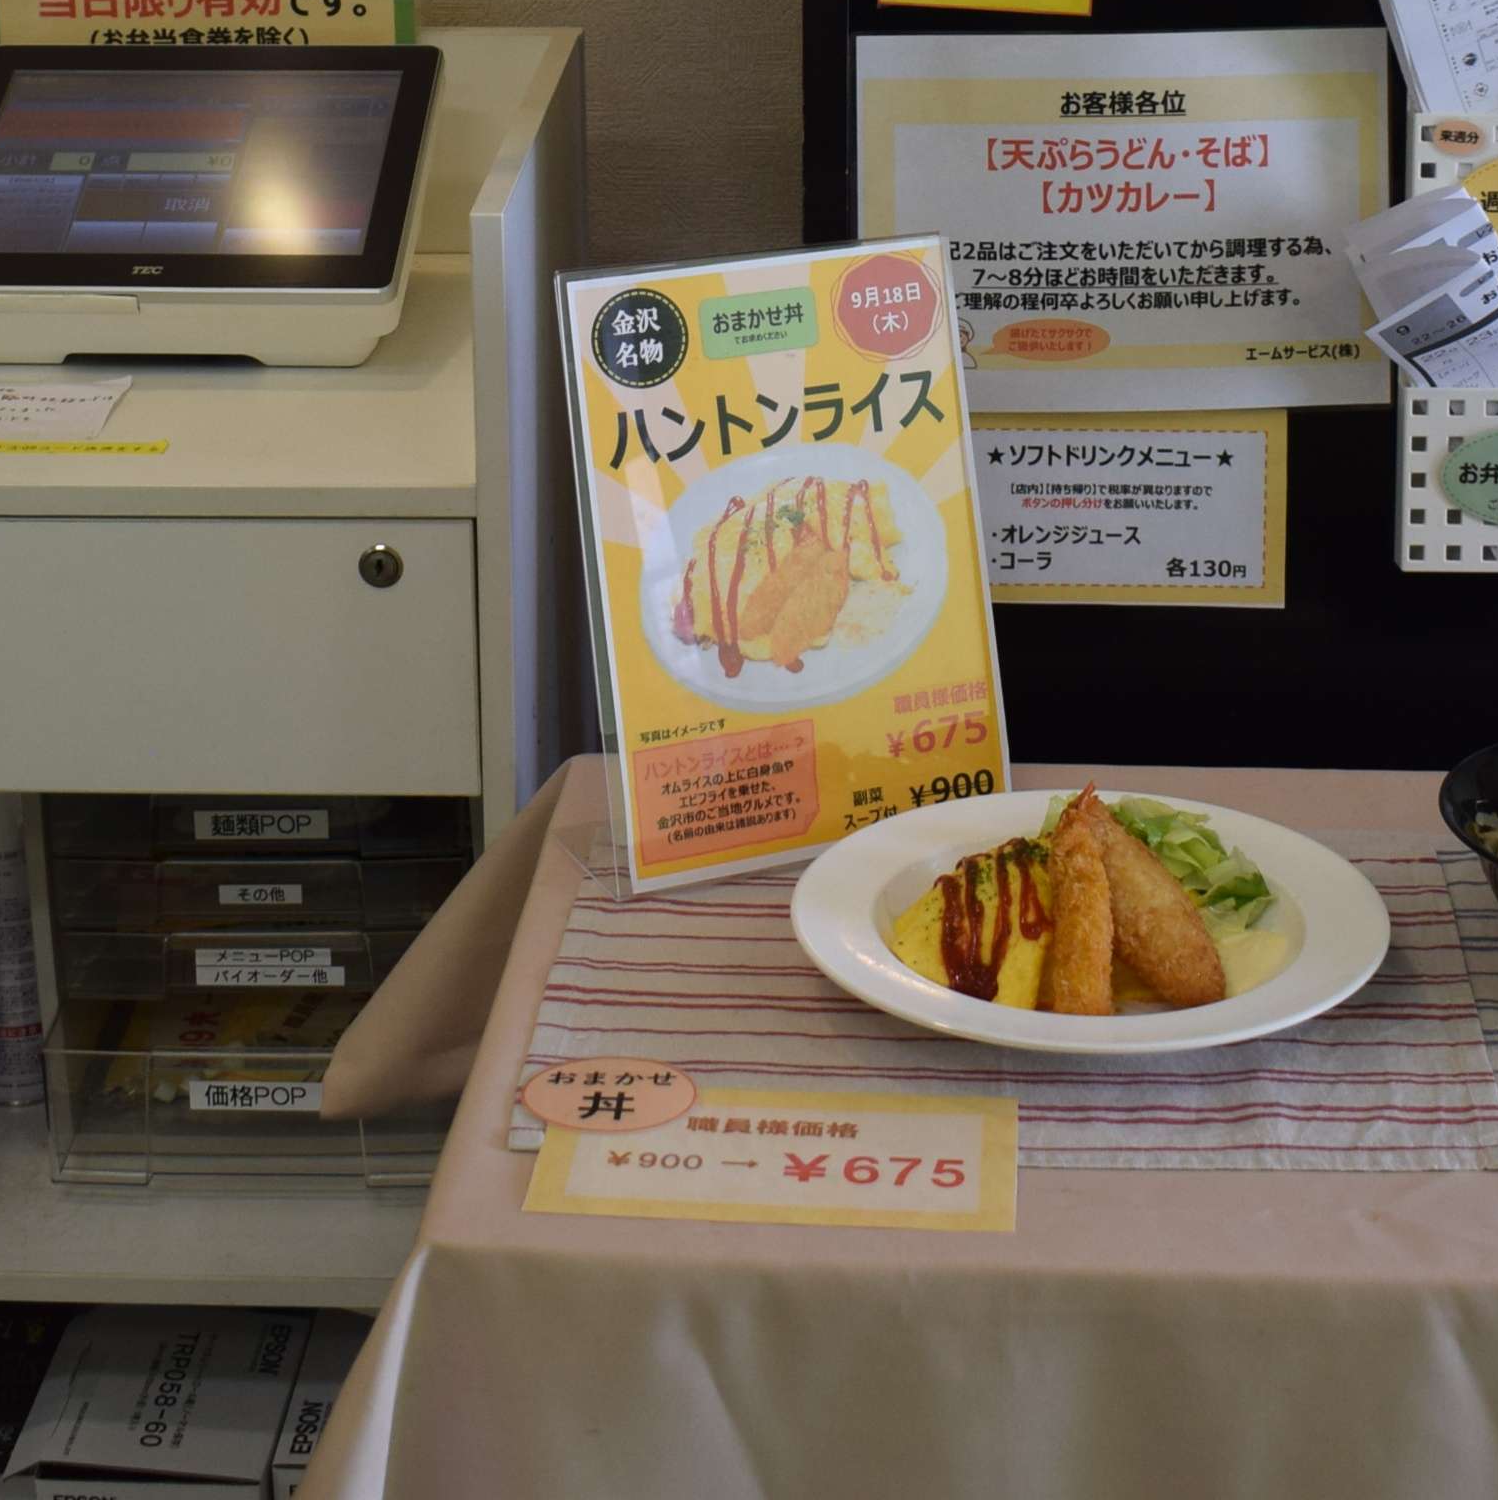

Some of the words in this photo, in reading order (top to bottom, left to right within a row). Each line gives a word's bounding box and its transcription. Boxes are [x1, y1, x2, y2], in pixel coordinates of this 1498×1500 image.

[1060, 88, 1187, 117] お客様各位
[986, 133, 1270, 173] 【天ぷらうどん・そば】
[1041, 178, 1216, 214] 【カツカレー】
[131, 265, 164, 276] TEC
[851, 280, 922, 310] 9月18日
[611, 306, 662, 337] 金沢
[711, 301, 804, 335] おまかせ丼
[615, 339, 664, 368] 名物
[609, 368, 947, 470] ハントンライス
[1009, 444, 1213, 469] ソフトドリンクメニュー
[1165, 556, 1247, 579] 各130円
[640, 718, 726, 743] 写真はイメージです
[886, 710, 989, 759] ¥675
[853, 787, 884, 807] 副菜
[908, 768, 995, 808] ¥900
[210, 813, 313, 837] 麺類POP
[237, 887, 286, 903] その他
[215, 949, 315, 963] メニューPOP
[214, 968, 329, 985] バイオーダー他
[547, 1070, 678, 1087] おまかせ
[204, 1084, 308, 1109] 価格POP
[577, 1091, 636, 1122] 丼
[687, 1116, 860, 1141] 職員様価格
[607, 1150, 704, 1172] ¥900
[782, 1152, 967, 1189] ¥675
[139, 1331, 201, 1448] TRP058-60
[290, 1401, 323, 1457] EPSON
